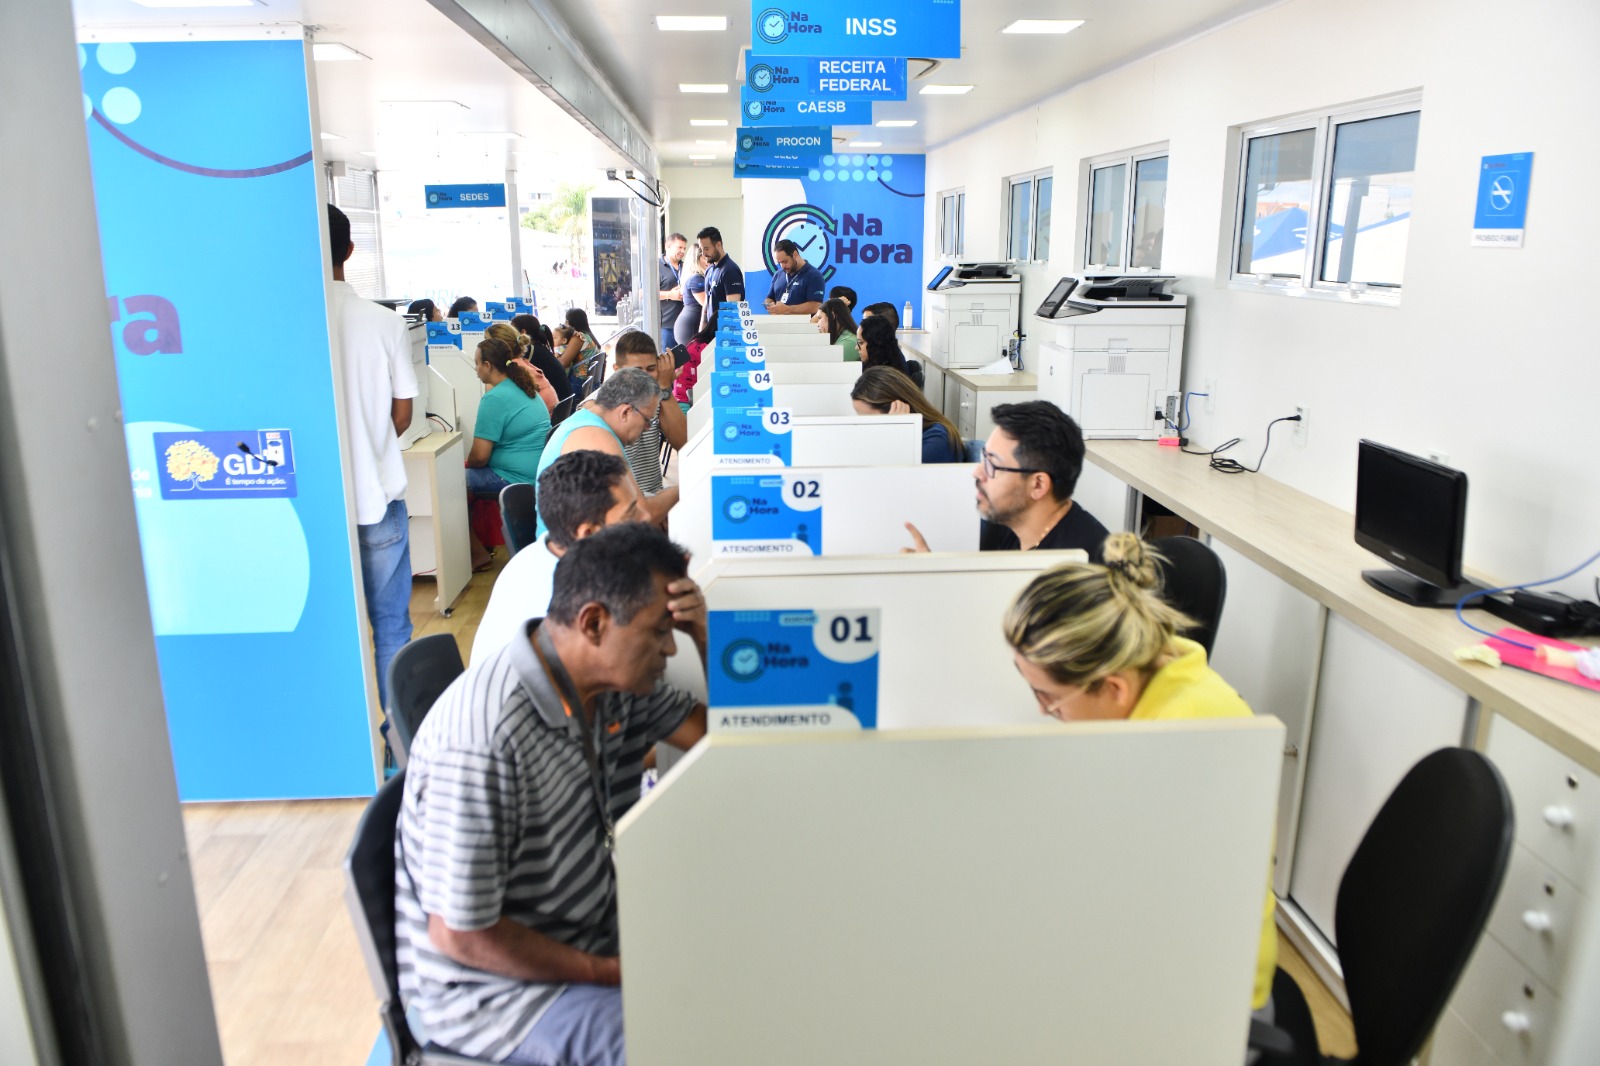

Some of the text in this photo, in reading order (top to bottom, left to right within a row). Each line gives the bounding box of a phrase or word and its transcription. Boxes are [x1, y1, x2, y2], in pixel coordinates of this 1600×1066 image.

[791, 12, 808, 22] Na
[787, 22, 823, 34] Hora
[845, 17, 897, 36] INSS
[775, 66, 789, 75] Na
[819, 60, 886, 74] RECEITA
[772, 74, 800, 84] Hora
[819, 78, 892, 92] FEDERAL
[763, 105, 785, 113] Hora
[797, 101, 846, 113] CAESB
[776, 136, 821, 146] PROCON
[460, 192, 490, 201] SEDES
[842, 213, 882, 236] Na
[835, 238, 913, 264] Hora
[451, 323, 460, 331] 13
[744, 319, 754, 327] 07
[746, 331, 758, 340] 06
[750, 348, 764, 357] 05
[754, 373, 771, 384] 04
[770, 411, 790, 425] 03
[225, 477, 232, 485] É
[232, 478, 255, 486] tempo
[266, 478, 286, 486] ação.
[792, 480, 820, 498] 02
[752, 498, 768, 506] Na
[749, 507, 779, 515] Hora
[722, 545, 794, 553] ATENDIMENTO
[830, 616, 872, 642] 01
[767, 643, 791, 654] Na
[763, 655, 809, 668] Hora
[721, 713, 831, 727] ATENDIMENTO
